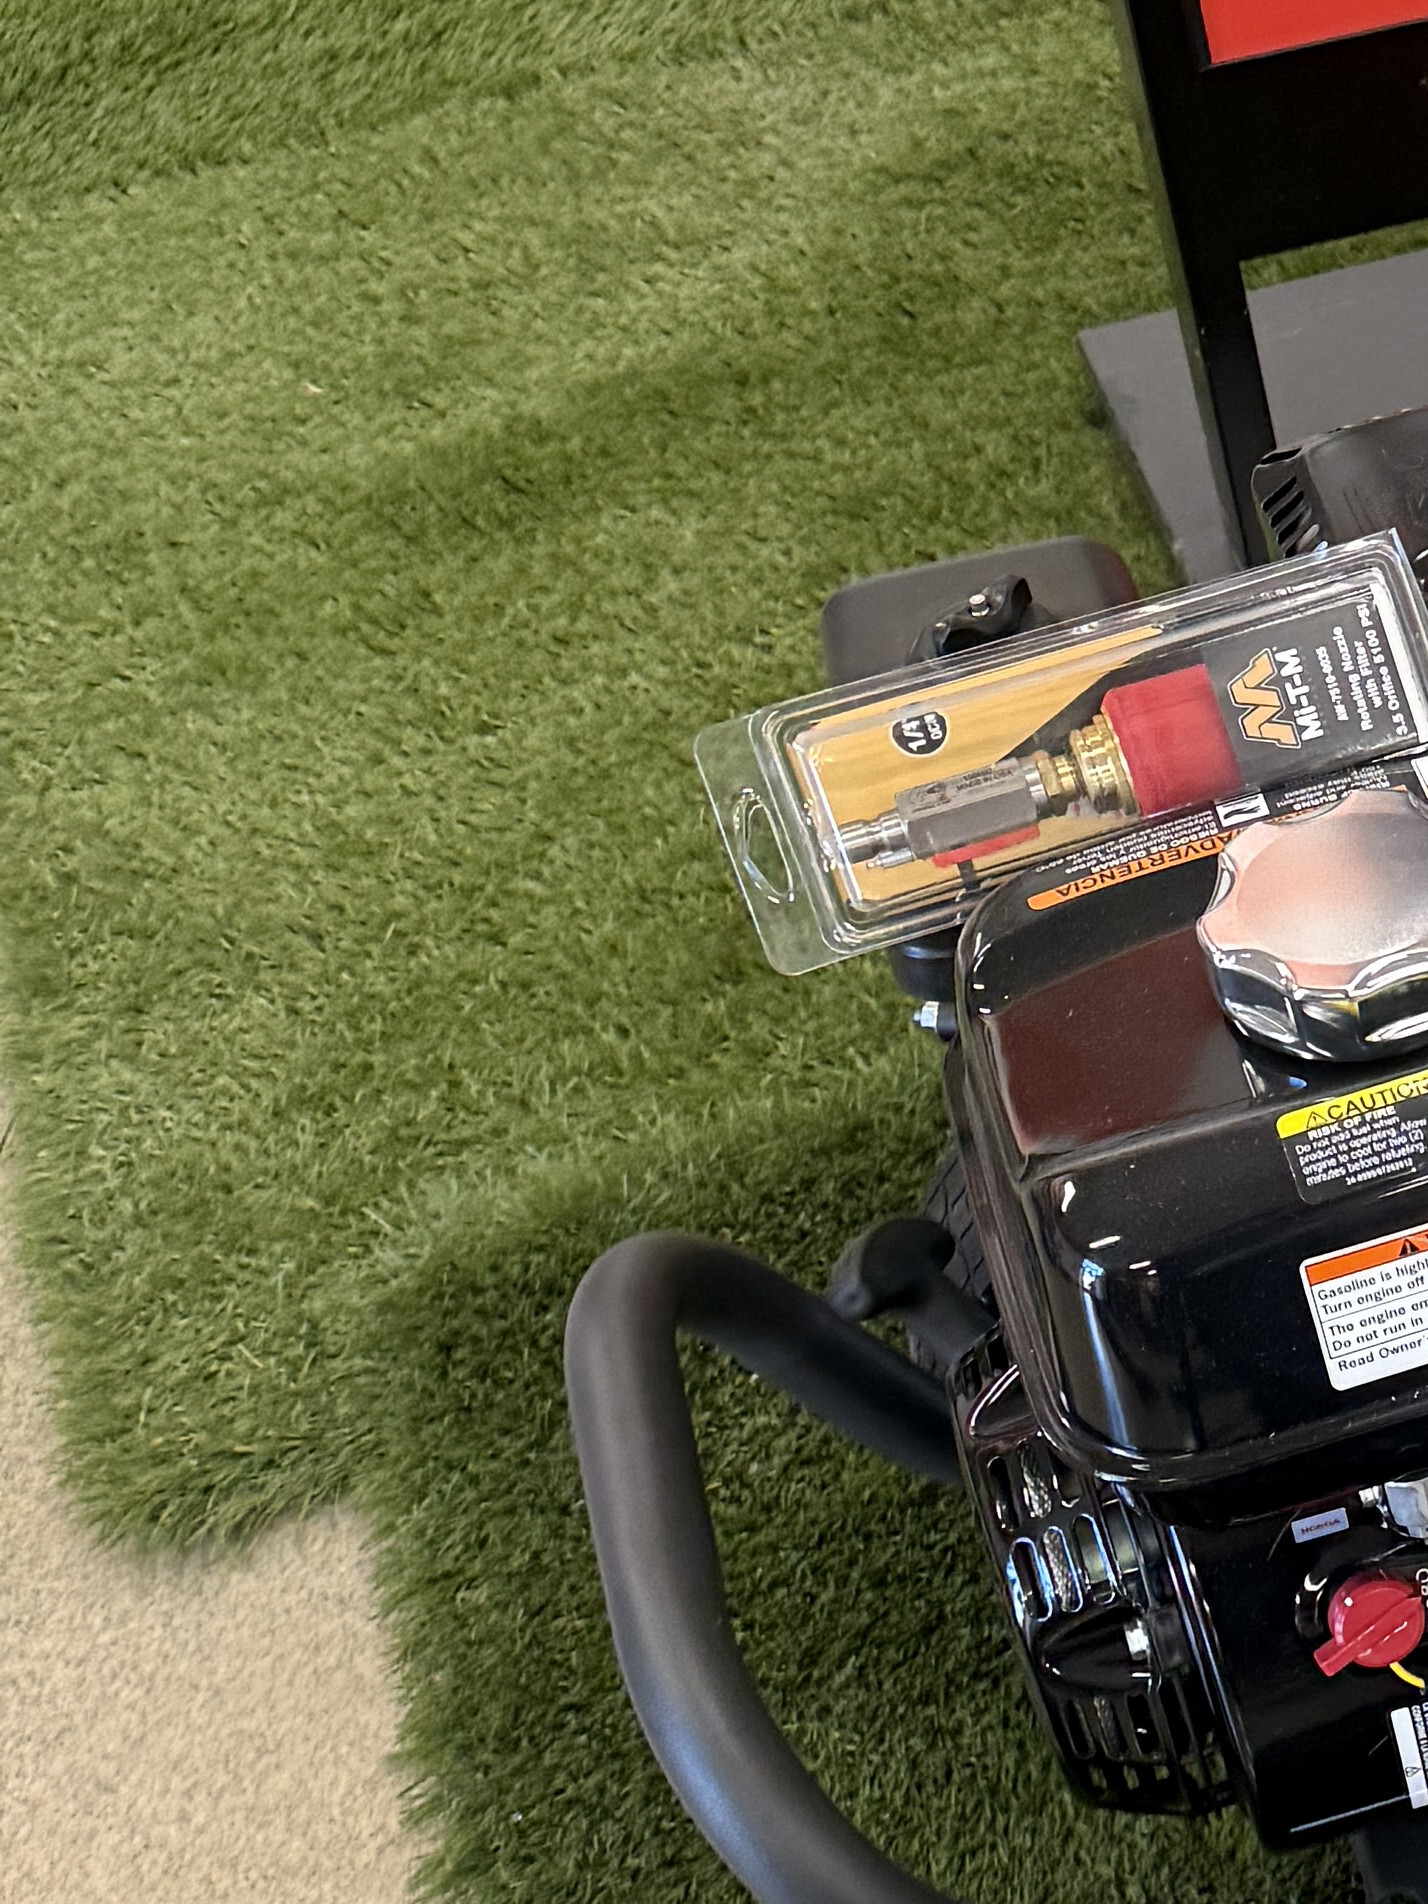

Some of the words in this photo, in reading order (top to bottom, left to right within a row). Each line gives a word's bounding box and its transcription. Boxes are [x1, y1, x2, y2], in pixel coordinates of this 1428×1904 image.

[1356, 603, 1374, 628] PSI
[1333, 626, 1355, 672] Nozzle
[1354, 640, 1373, 677] Filter
[1366, 629, 1385, 664] 5100
[1274, 648, 1324, 741] Mi-T-M
[1348, 673, 1374, 731] Rotating
[1366, 678, 1383, 708] with
[1379, 666, 1400, 711] Orifice
[1392, 713, 1408, 735] 3.5
[1294, 1143, 1311, 1155] Do
[1312, 1136, 1330, 1149] not
[1371, 1115, 1399, 1129] when
[1307, 1122, 1341, 1140] RISK
[1342, 1115, 1361, 1128] OF
[1364, 1105, 1396, 1121] FIRE
[1298, 1145, 1337, 1166] product
[1400, 1118, 1426, 1131] Allow
[1301, 1157, 1336, 1174] engine
[1349, 1145, 1372, 1159] cool
[1387, 1135, 1407, 1147] two
[1408, 1128, 1424, 1142] (2)
[1306, 1166, 1346, 1185] minutes
[1346, 1155, 1379, 1172] before
[1317, 1277, 1375, 1300] Gasoline
[1379, 1270, 1392, 1282] is
[1321, 1300, 1352, 1314] Turn
[1356, 1284, 1402, 1304] engine
[1406, 1275, 1424, 1289] off
[1328, 1323, 1354, 1336] The
[1359, 1306, 1405, 1327] engine
[1332, 1339, 1351, 1351] Do
[1355, 1329, 1378, 1343] not
[1382, 1322, 1406, 1335] run
[1410, 1316, 1423, 1327] in
[1337, 1351, 1374, 1371] Read
